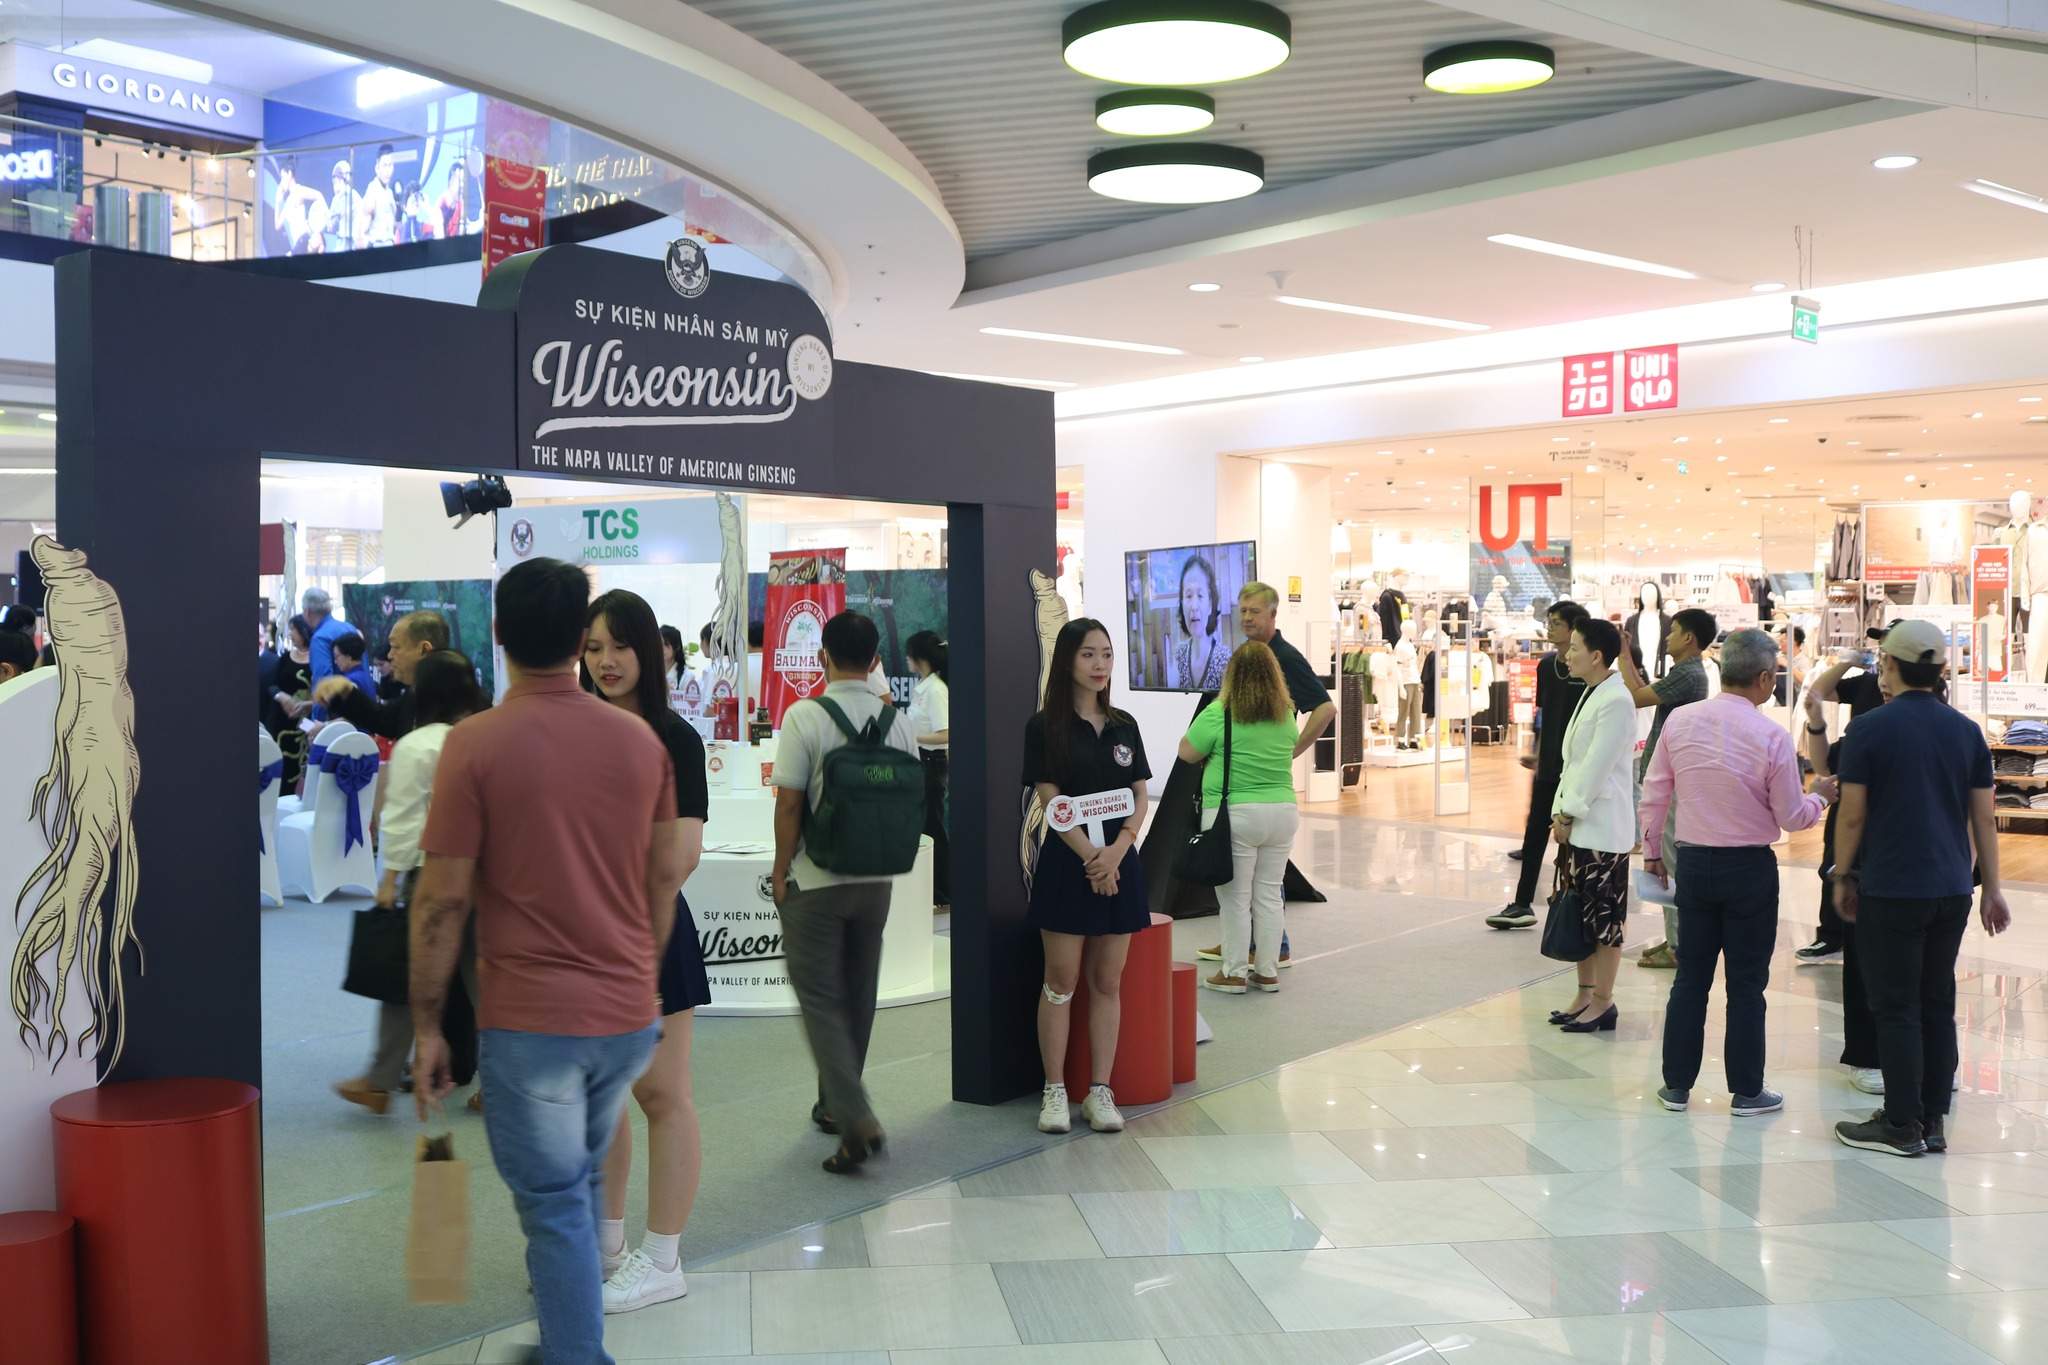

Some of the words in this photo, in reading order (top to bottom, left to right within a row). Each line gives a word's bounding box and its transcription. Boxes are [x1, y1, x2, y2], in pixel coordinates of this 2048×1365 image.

[52, 63, 235, 118] GIORDANO
[676, 239, 698, 249] GINSENG
[667, 269, 681, 290] BOARD
[687, 275, 709, 295] WISCONSIN
[575, 299, 604, 325] SỰ
[611, 304, 656, 331] KIỆN
[664, 312, 715, 338] NHÂN
[722, 320, 759, 345] SÂM
[765, 327, 790, 348] MỸ
[532, 338, 794, 408] Wisconsin
[1630, 353, 1669, 380] UNI
[1630, 378, 1673, 408] QLO
[532, 445, 558, 466] THE
[565, 447, 601, 470] NAPA
[607, 451, 654, 474] VALLEY
[659, 456, 674, 474] OF
[679, 457, 743, 481] AMERICAN
[748, 463, 796, 485] GINSENG
[582, 508, 639, 540] TCS
[1479, 483, 1562, 551] UT
[583, 545, 639, 559] HOLDINGS
[785, 603, 825, 625] WISCONSIN
[789, 672, 817, 681] GINSENG
[677, 708, 687, 716] ITH
[688, 708, 700, 716] LOVE
[1079, 798, 1103, 808] GINSENG
[1104, 795, 1122, 804] BOARD
[1081, 802, 1128, 818] WISCONSIN
[704, 911, 719, 922] SỰ
[724, 911, 751, 922] KIỆN
[755, 910, 779, 920] NHÂ
[707, 977, 718, 986] PA
[720, 976, 747, 986] VALLEY
[751, 976, 761, 986] OF
